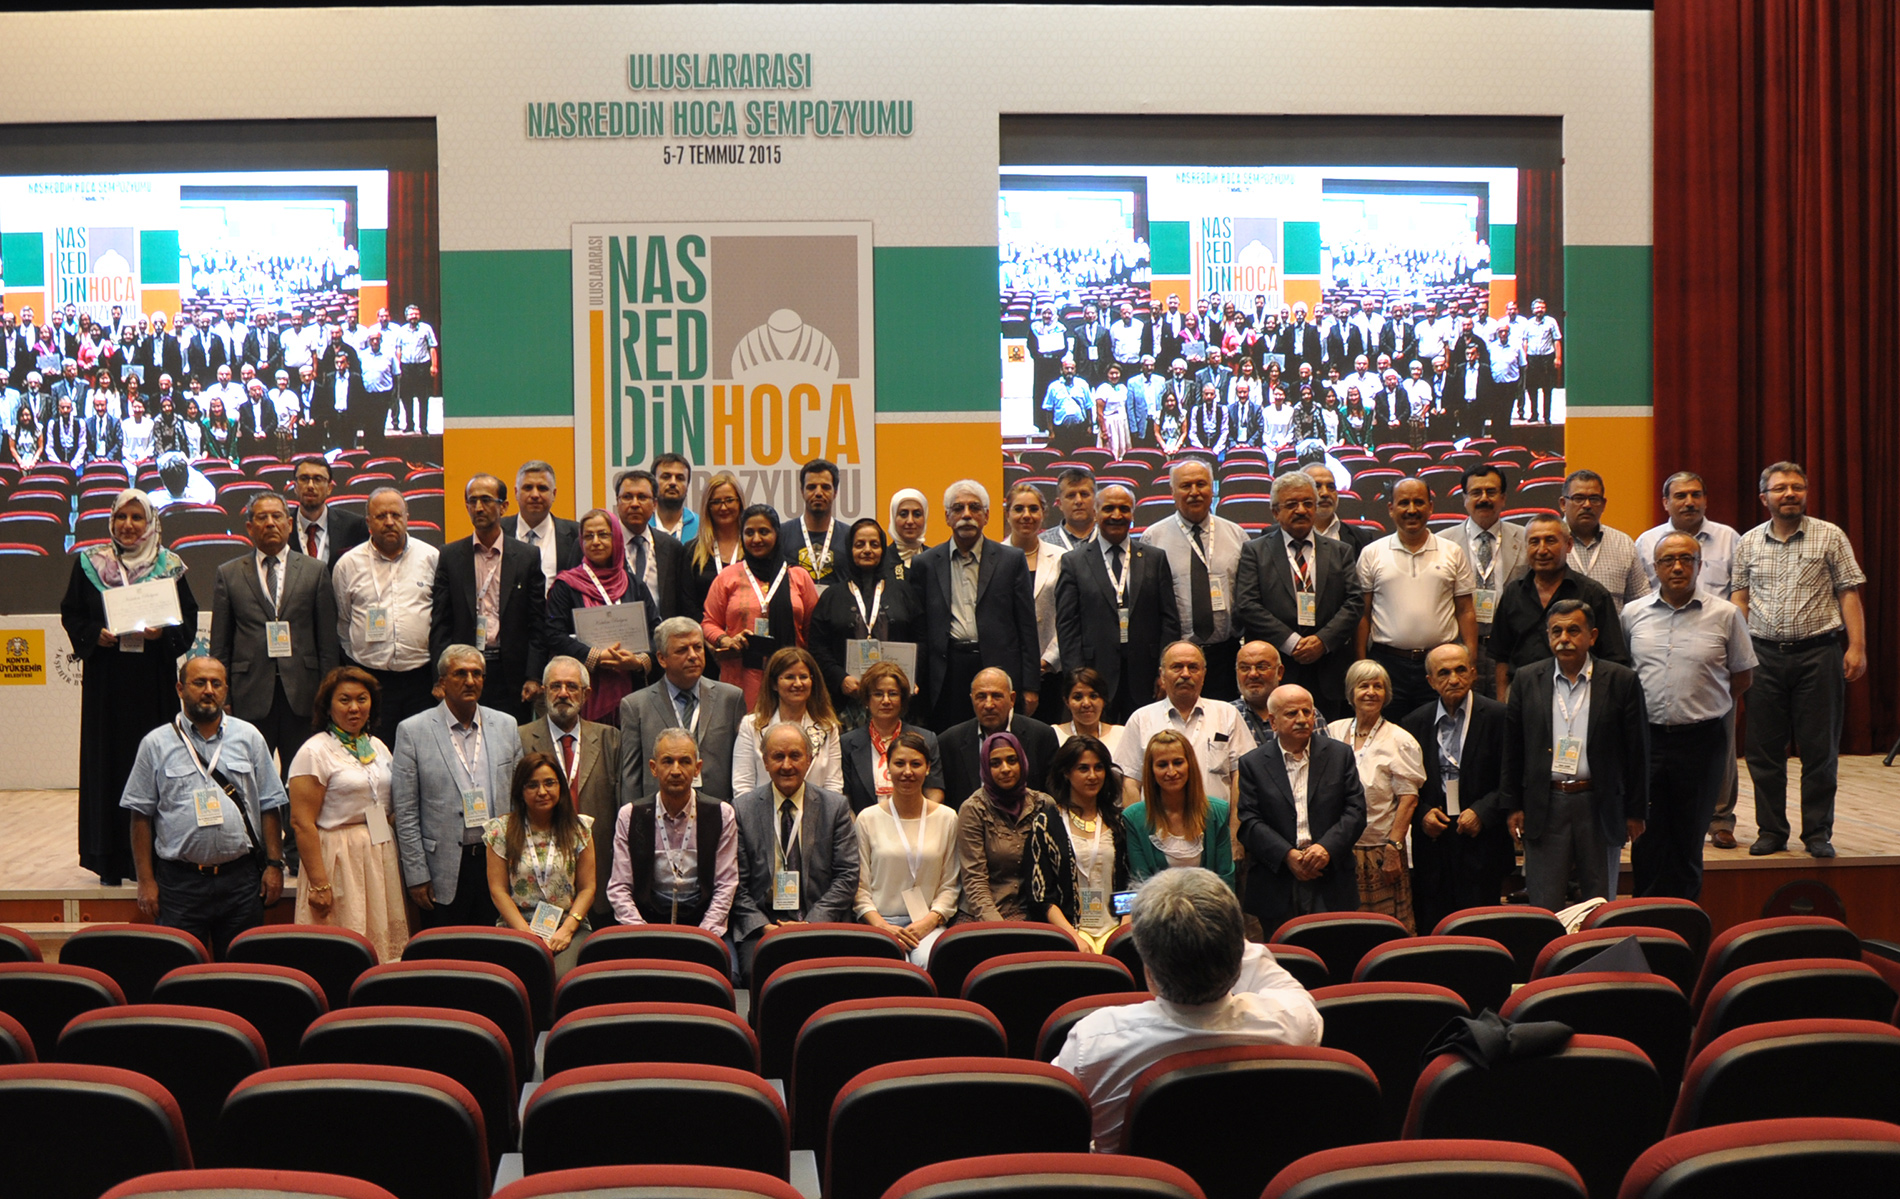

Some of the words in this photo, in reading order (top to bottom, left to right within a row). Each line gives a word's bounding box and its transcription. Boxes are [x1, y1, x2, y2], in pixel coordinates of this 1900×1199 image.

[630, 53, 812, 90] ULUSLARARASI
[673, 101, 738, 137] HOCA
[746, 101, 914, 136] SEMPOZYUMU
[663, 146, 685, 164] 5-7
[688, 145, 746, 164] TEMMUZ
[749, 145, 781, 163] 2015
[55, 226, 87, 248] NAS
[1201, 216, 1232, 239] NAS
[588, 235, 604, 306] ULUSLARARASI
[609, 234, 707, 304] NAS
[611, 309, 708, 381] RED
[712, 383, 861, 466] HOCA
[0, 663, 43, 673] ÜYÜKŞEHİR
